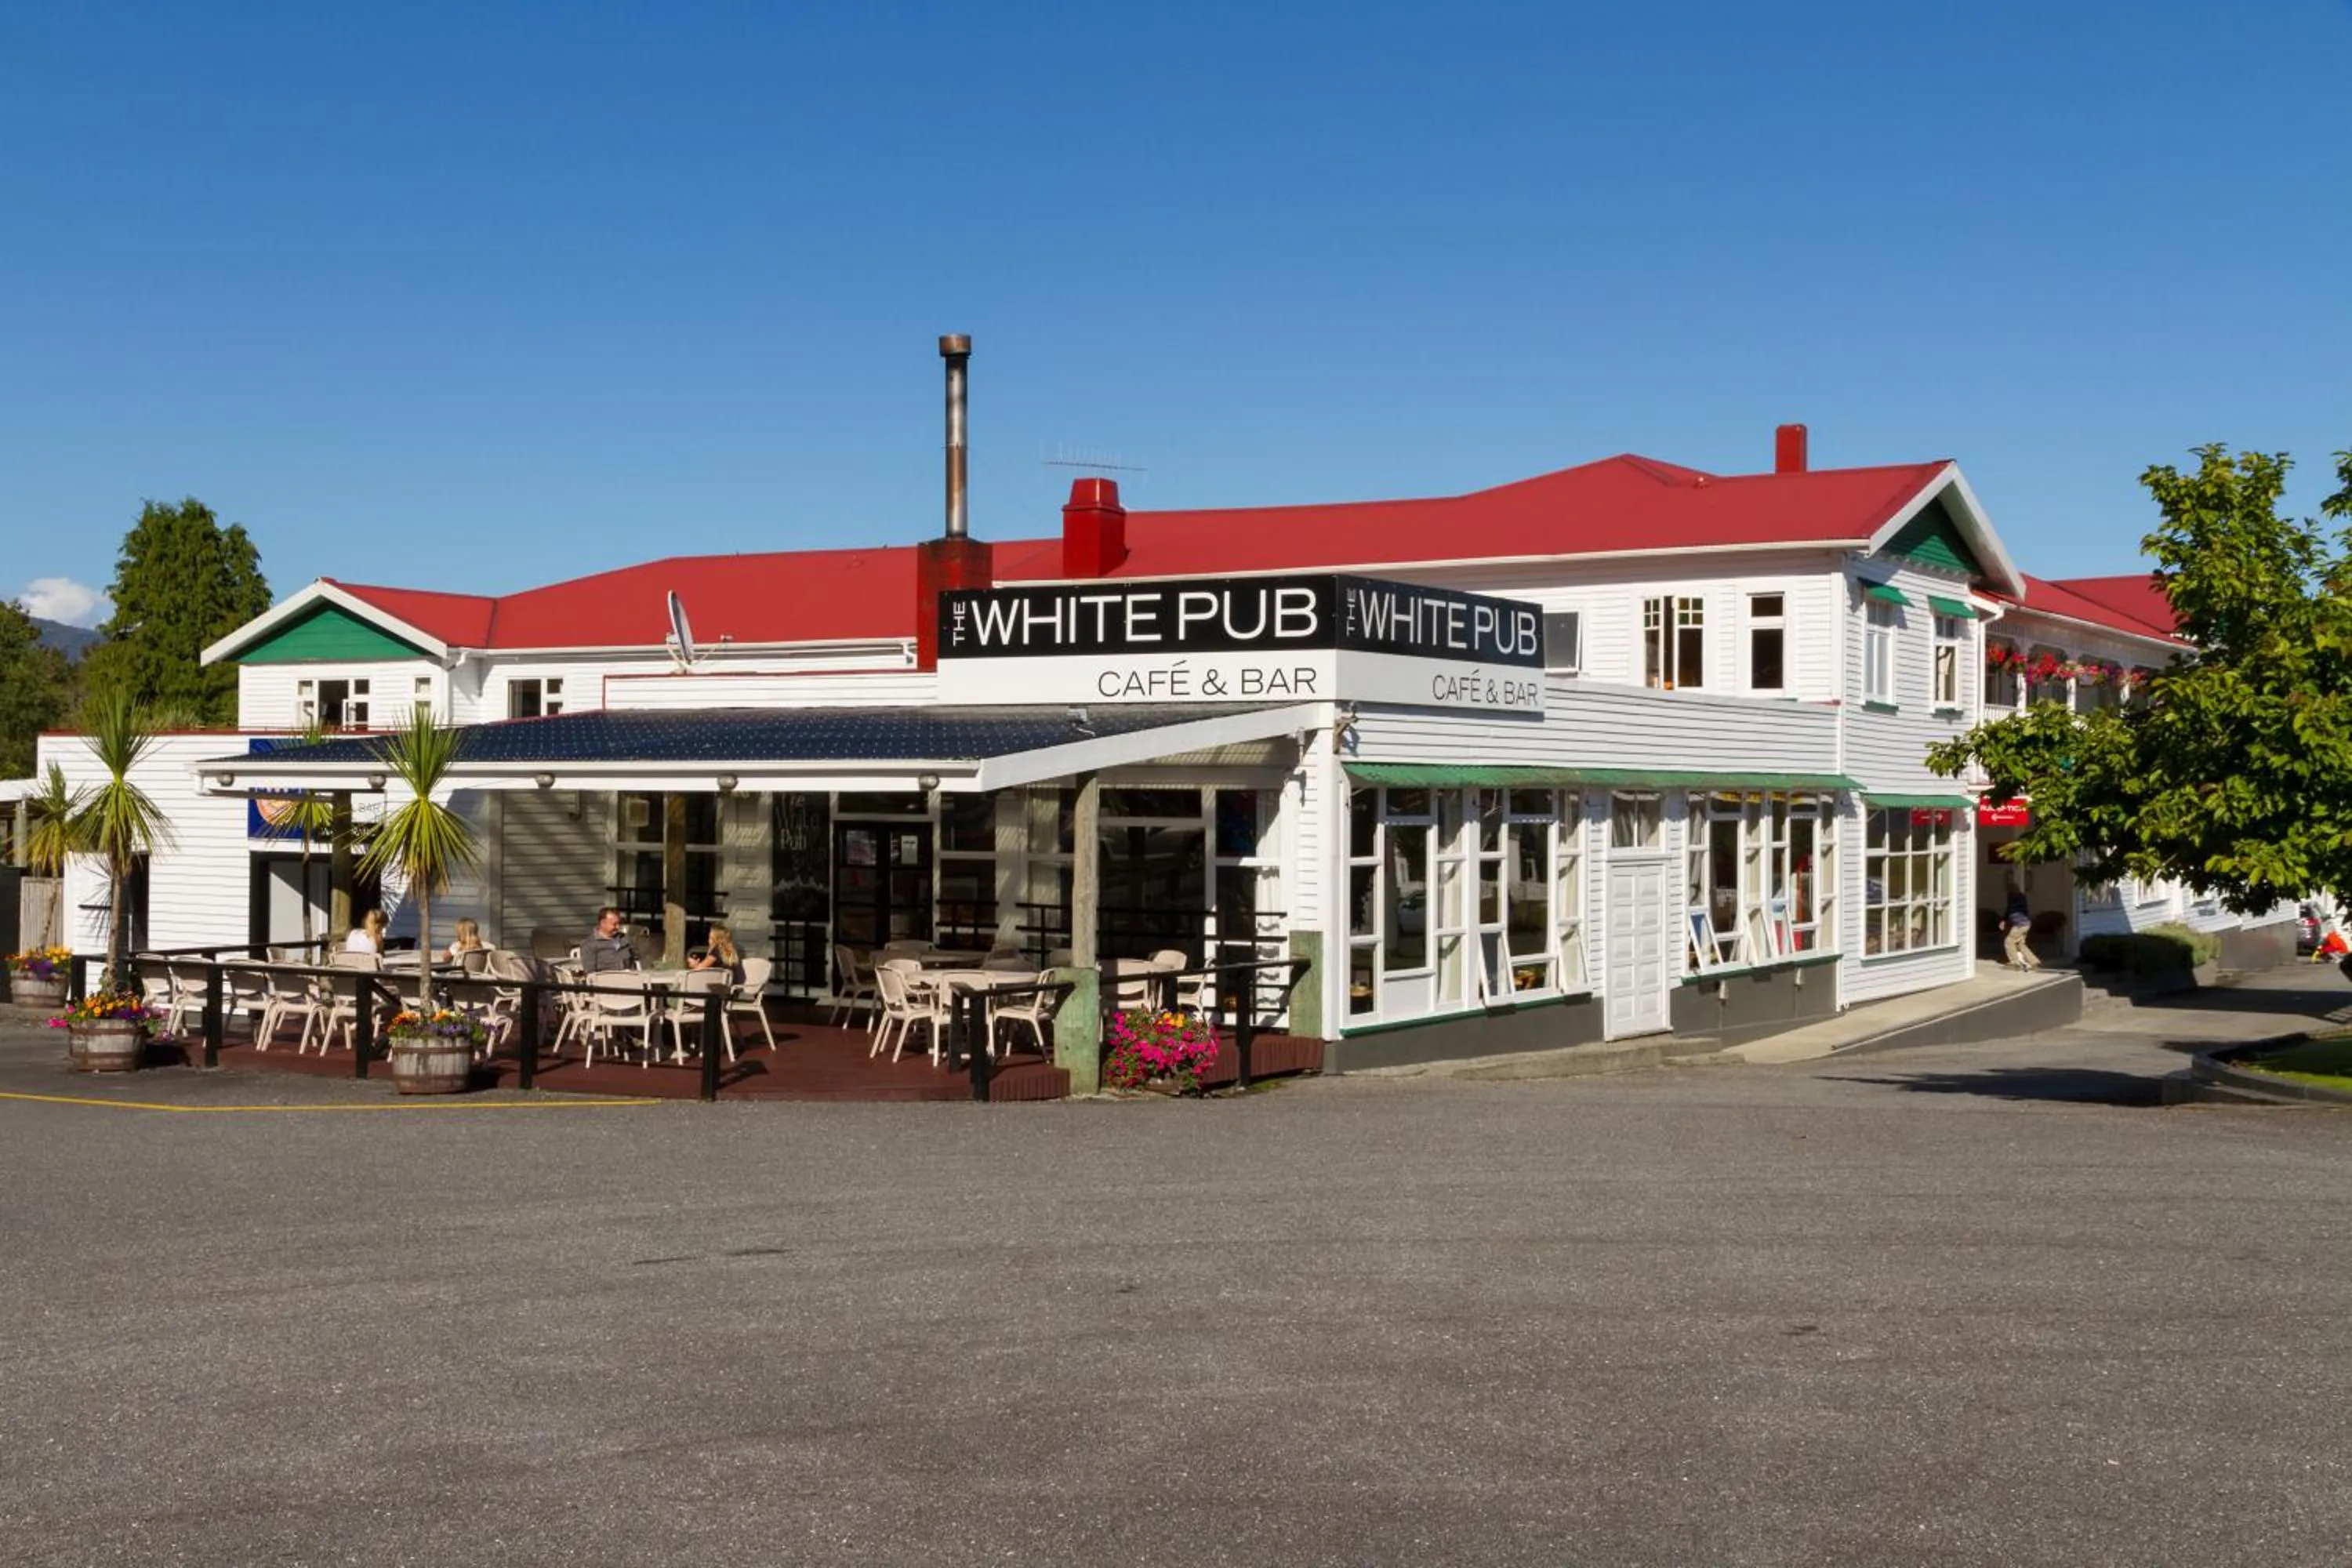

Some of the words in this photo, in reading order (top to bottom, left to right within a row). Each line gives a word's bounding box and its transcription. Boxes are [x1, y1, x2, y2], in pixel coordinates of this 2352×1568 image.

[953, 601, 966, 647] THE
[971, 593, 1162, 646] WHITE
[1178, 588, 1318, 640] PUB
[1346, 588, 1356, 637] THE
[1359, 590, 1467, 649] WHITE
[1474, 605, 1537, 655] PUB
[1098, 659, 1190, 697] CAFÉ
[1202, 669, 1228, 695] &
[1241, 667, 1316, 695] BAR
[1432, 669, 1481, 703] CAFÉ
[1486, 679, 1499, 704] &
[1504, 681, 1537, 706] BAR
